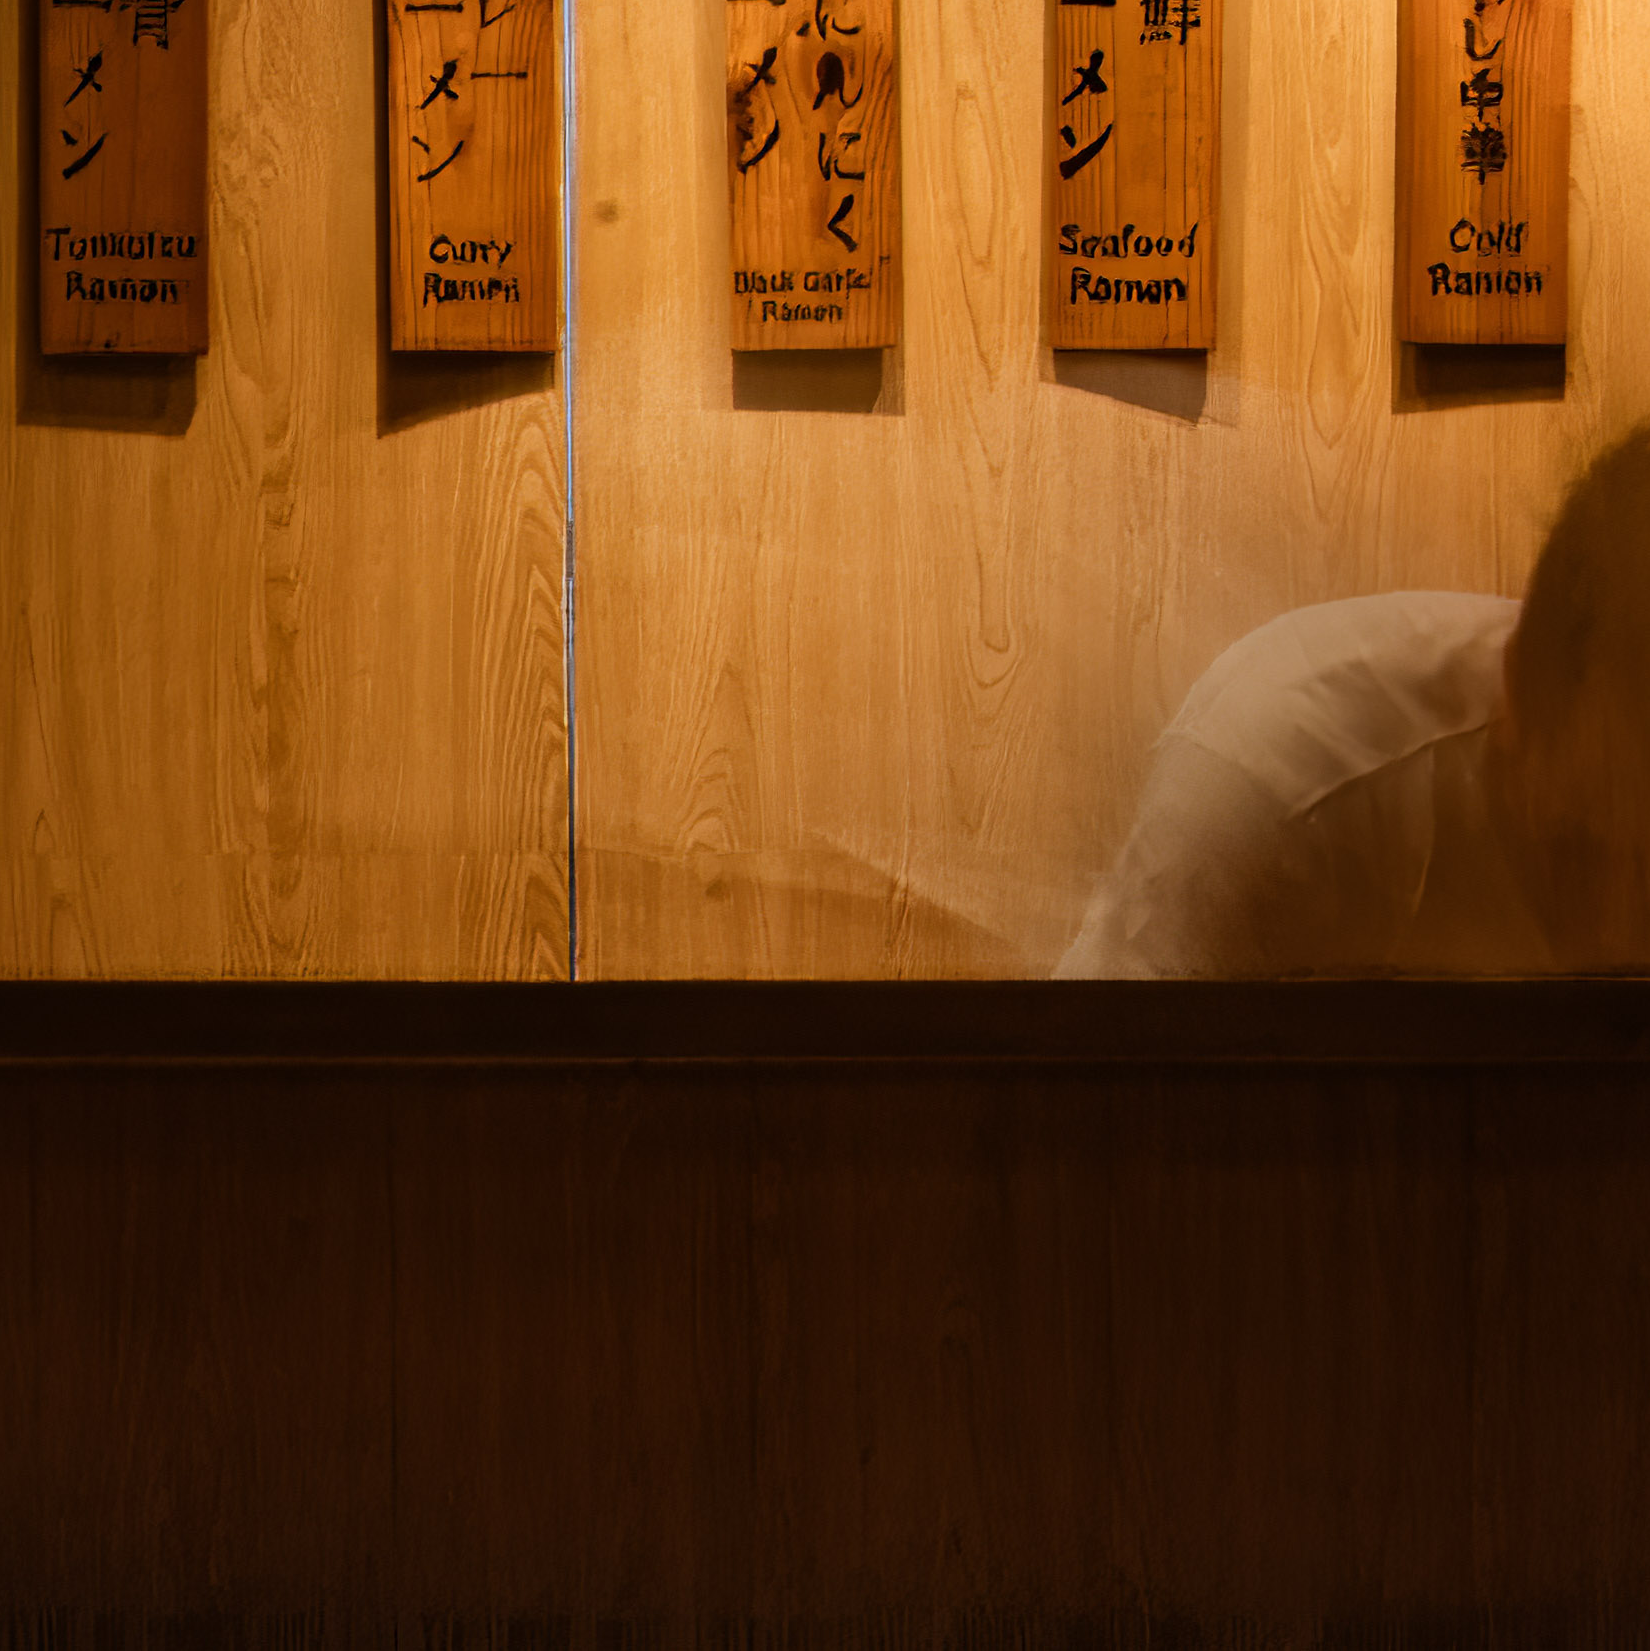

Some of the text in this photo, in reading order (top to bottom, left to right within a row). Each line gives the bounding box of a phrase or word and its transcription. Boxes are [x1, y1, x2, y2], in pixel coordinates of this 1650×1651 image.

[428, 235, 514, 269] Curry
[1059, 223, 1198, 258] Seafood
[1450, 217, 1529, 258] Cold
[66, 271, 179, 303] Ramen
[423, 272, 520, 307] Ramen
[1070, 268, 1188, 304] Ramen
[1428, 264, 1544, 297] Ramen
